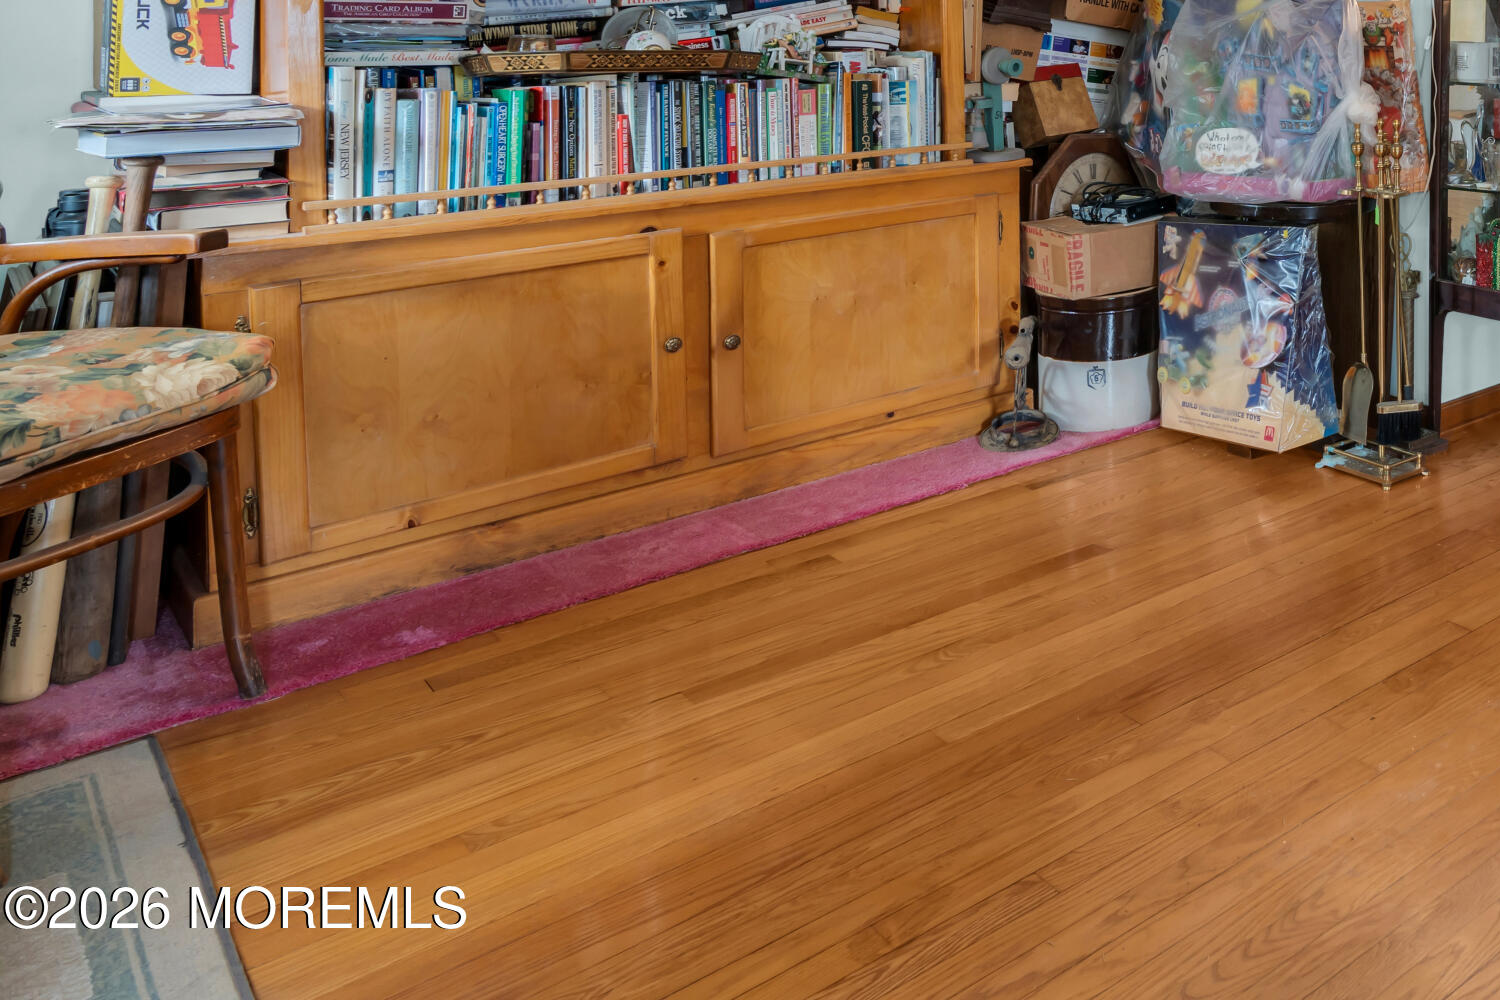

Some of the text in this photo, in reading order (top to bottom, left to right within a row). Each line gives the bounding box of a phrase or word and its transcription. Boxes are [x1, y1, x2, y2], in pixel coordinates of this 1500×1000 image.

[331, 3, 433, 13] TRADING CARD ALBUM
[1111, 0, 1129, 11] WITH
[484, 26, 515, 40] WYMAN
[519, 23, 548, 35] STONE
[552, 20, 578, 34] ALONE
[384, 92, 391, 102] BY
[674, 124, 682, 150] SELECTOR
[768, 118, 776, 136] Money
[497, 105, 507, 172] OPEN HEART SURGERY
[566, 134, 574, 156] Options
[340, 124, 350, 180] NEW JERSEY
[384, 138, 392, 168] ALONE
[1070, 234, 1085, 293] FRAGILE
[1182, 401, 1261, 422] BUILD TOYS
